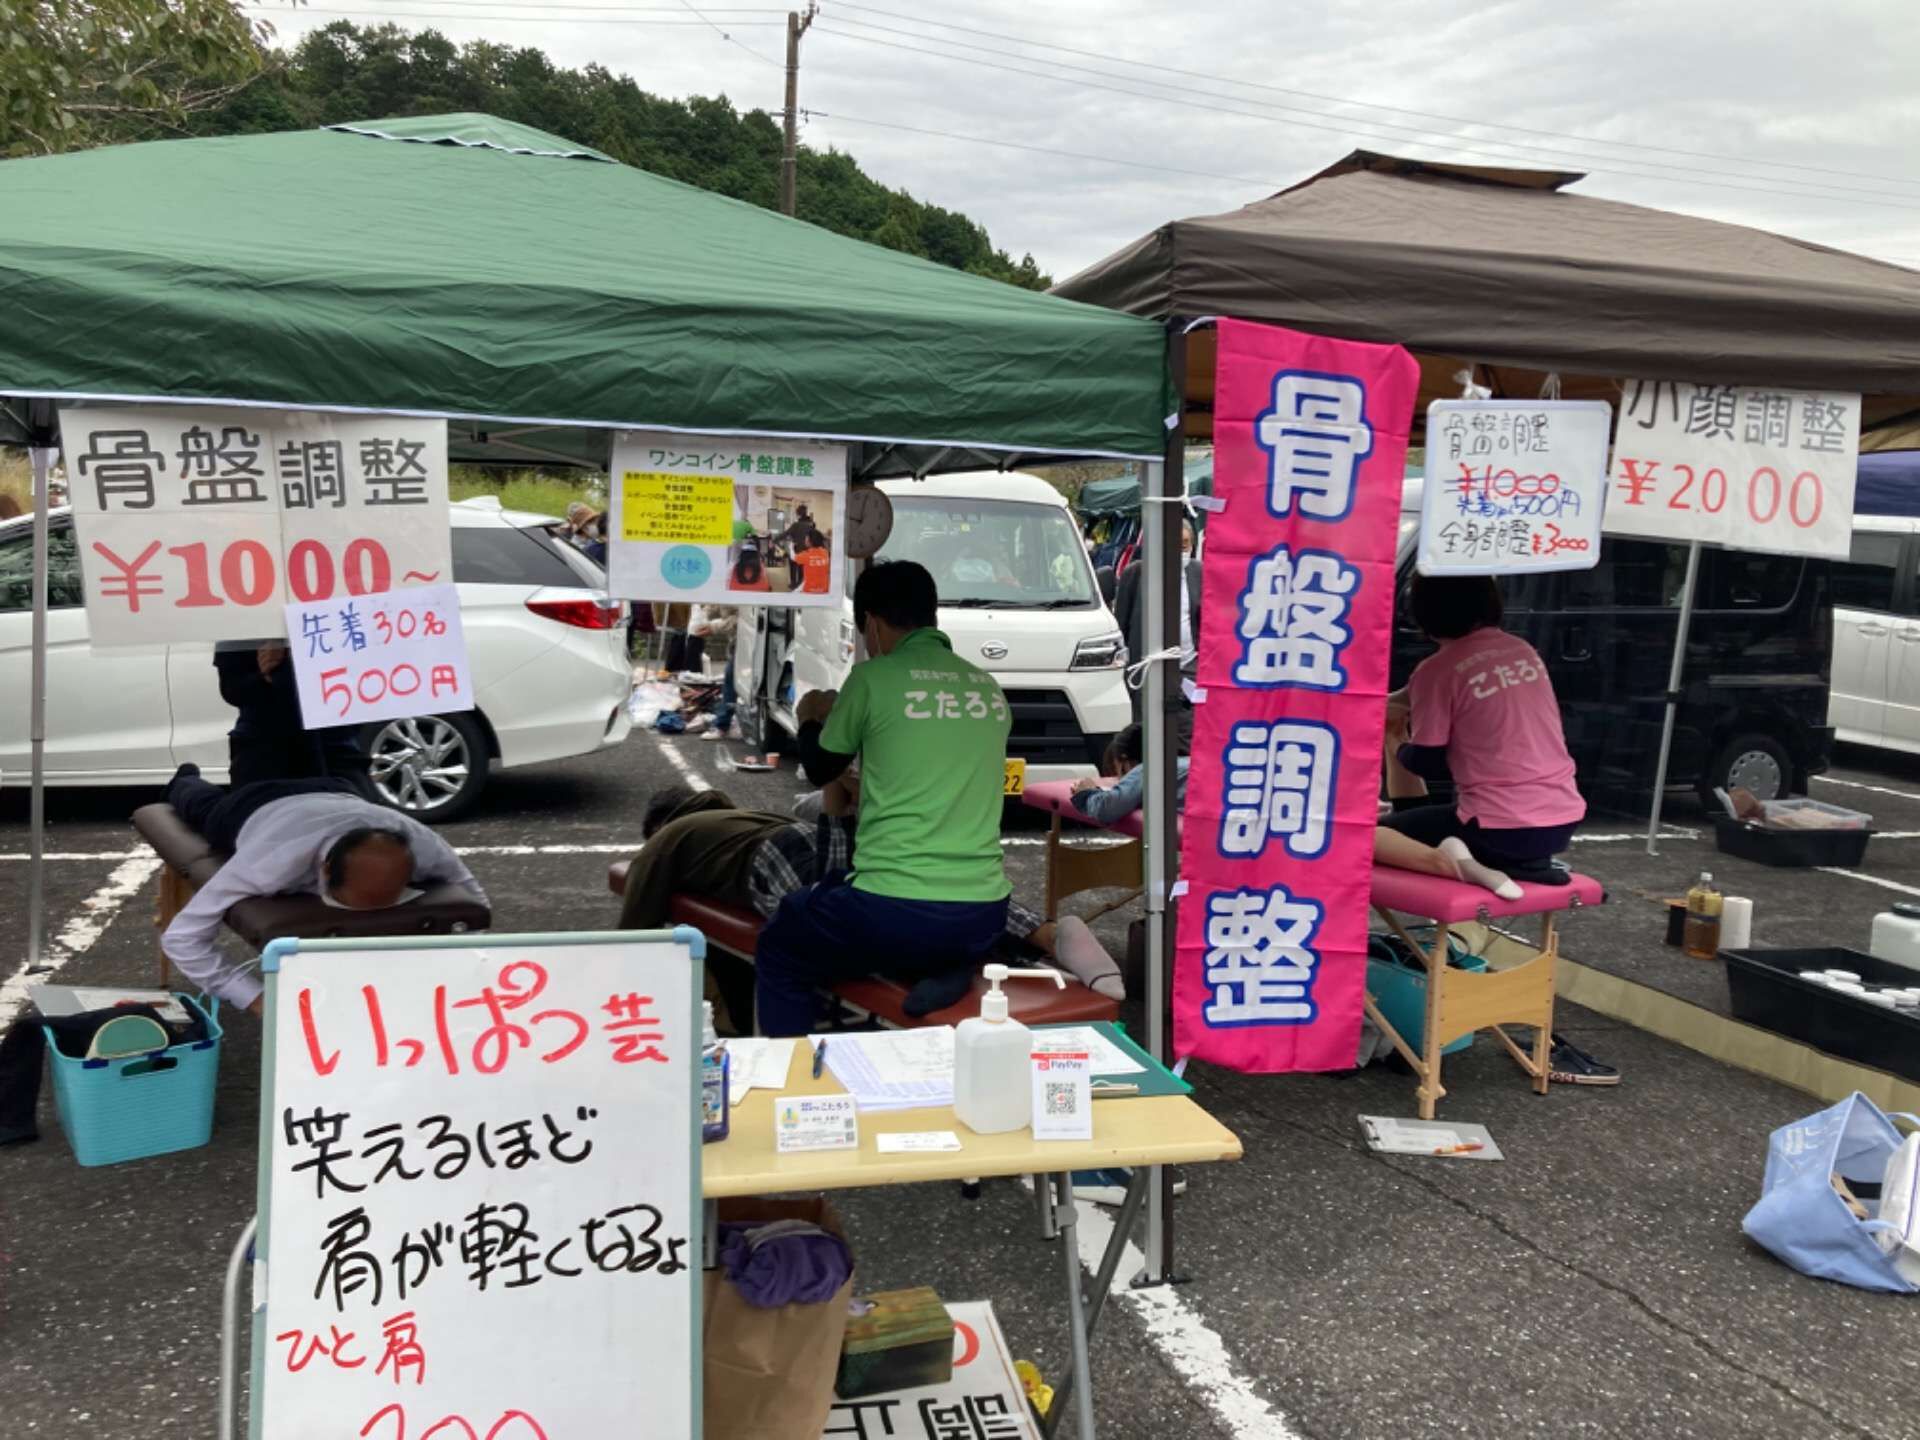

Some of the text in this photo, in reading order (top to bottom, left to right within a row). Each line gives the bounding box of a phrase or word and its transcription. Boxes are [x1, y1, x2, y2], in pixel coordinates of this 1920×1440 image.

[1628, 381, 1847, 453] 小顔調整
[78, 426, 429, 510] 骨盤調整
[648, 449, 814, 477] ワンコイン骨盤調整
[319, 664, 458, 717] 500円
[1205, 369, 1374, 1028] 骨盤調整
[298, 960, 669, 1076] いっぱつ芸
[1051, 1060, 1083, 1070] PayPay
[283, 1105, 598, 1199] 笑えるほど
[313, 1202, 689, 1312] 肩が軽くなるよ
[276, 1311, 426, 1384] ひと肩
